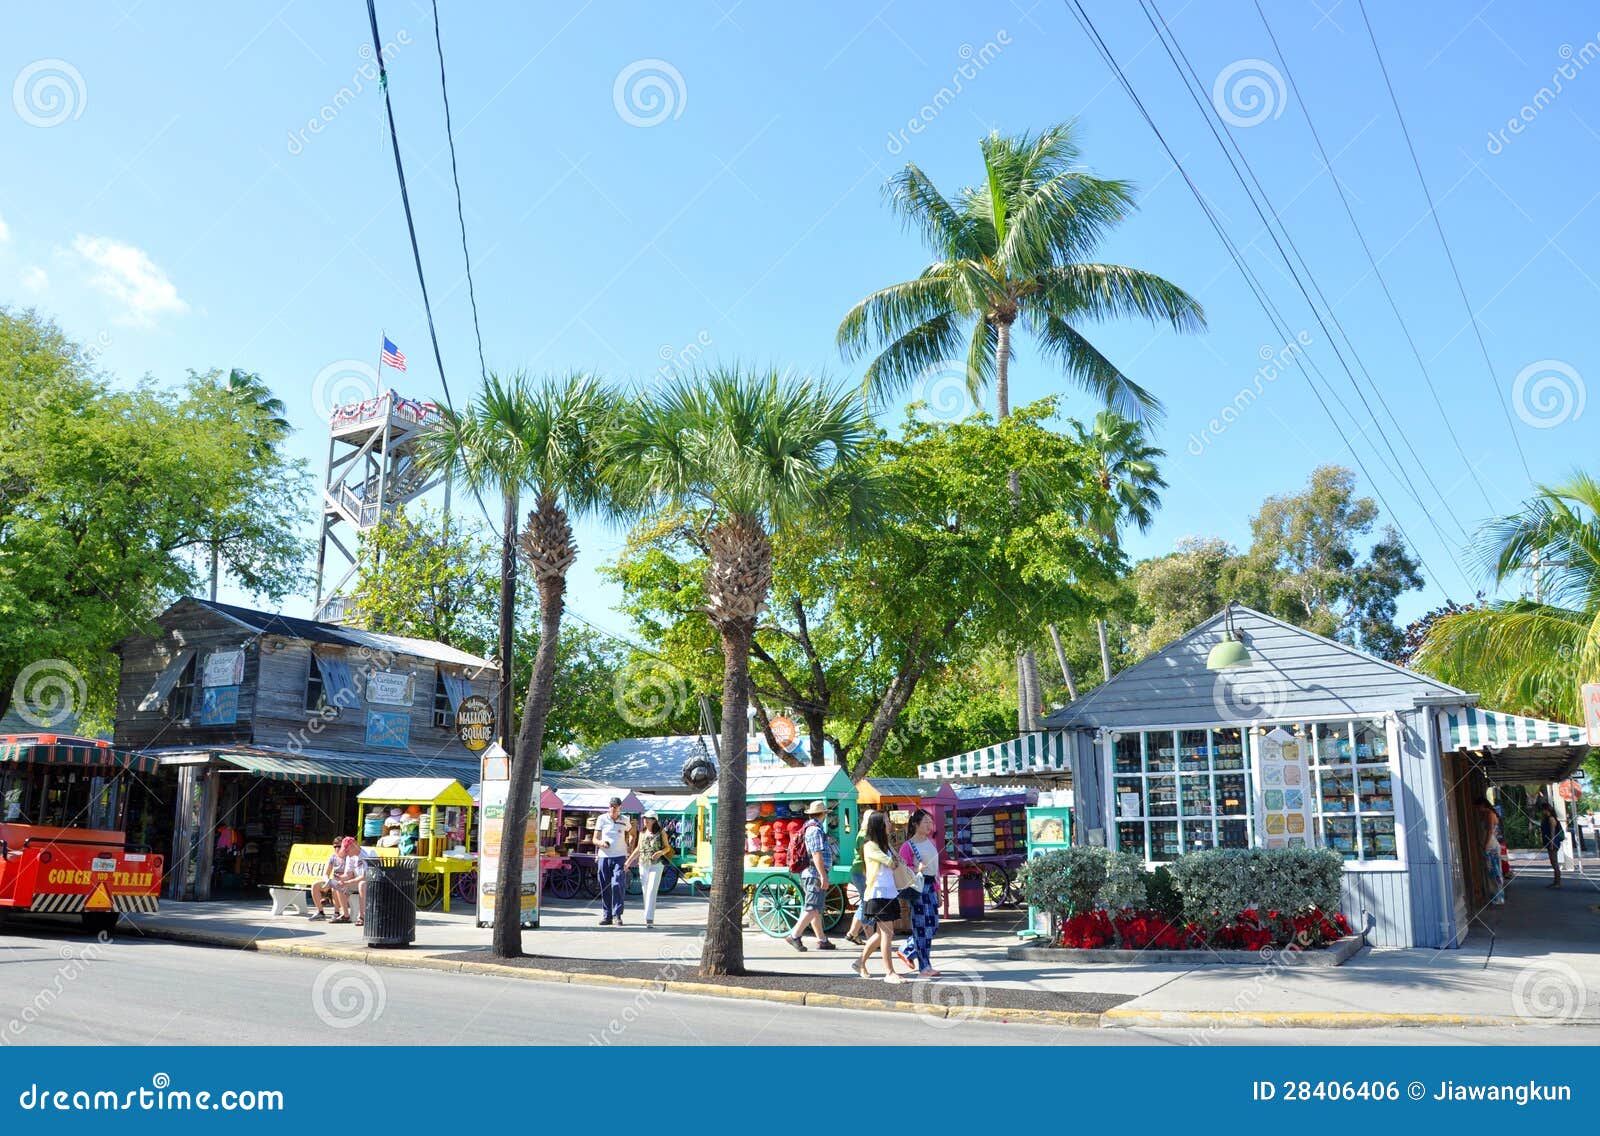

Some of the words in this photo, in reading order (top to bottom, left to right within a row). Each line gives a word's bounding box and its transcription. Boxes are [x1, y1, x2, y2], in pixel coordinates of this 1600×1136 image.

[459, 711, 492, 725] MALLORY
[462, 726, 492, 746] SQUARE
[292, 861, 326, 876] CONCH
[48, 869, 93, 885] CONCH
[112, 872, 154, 887] TRAIN
